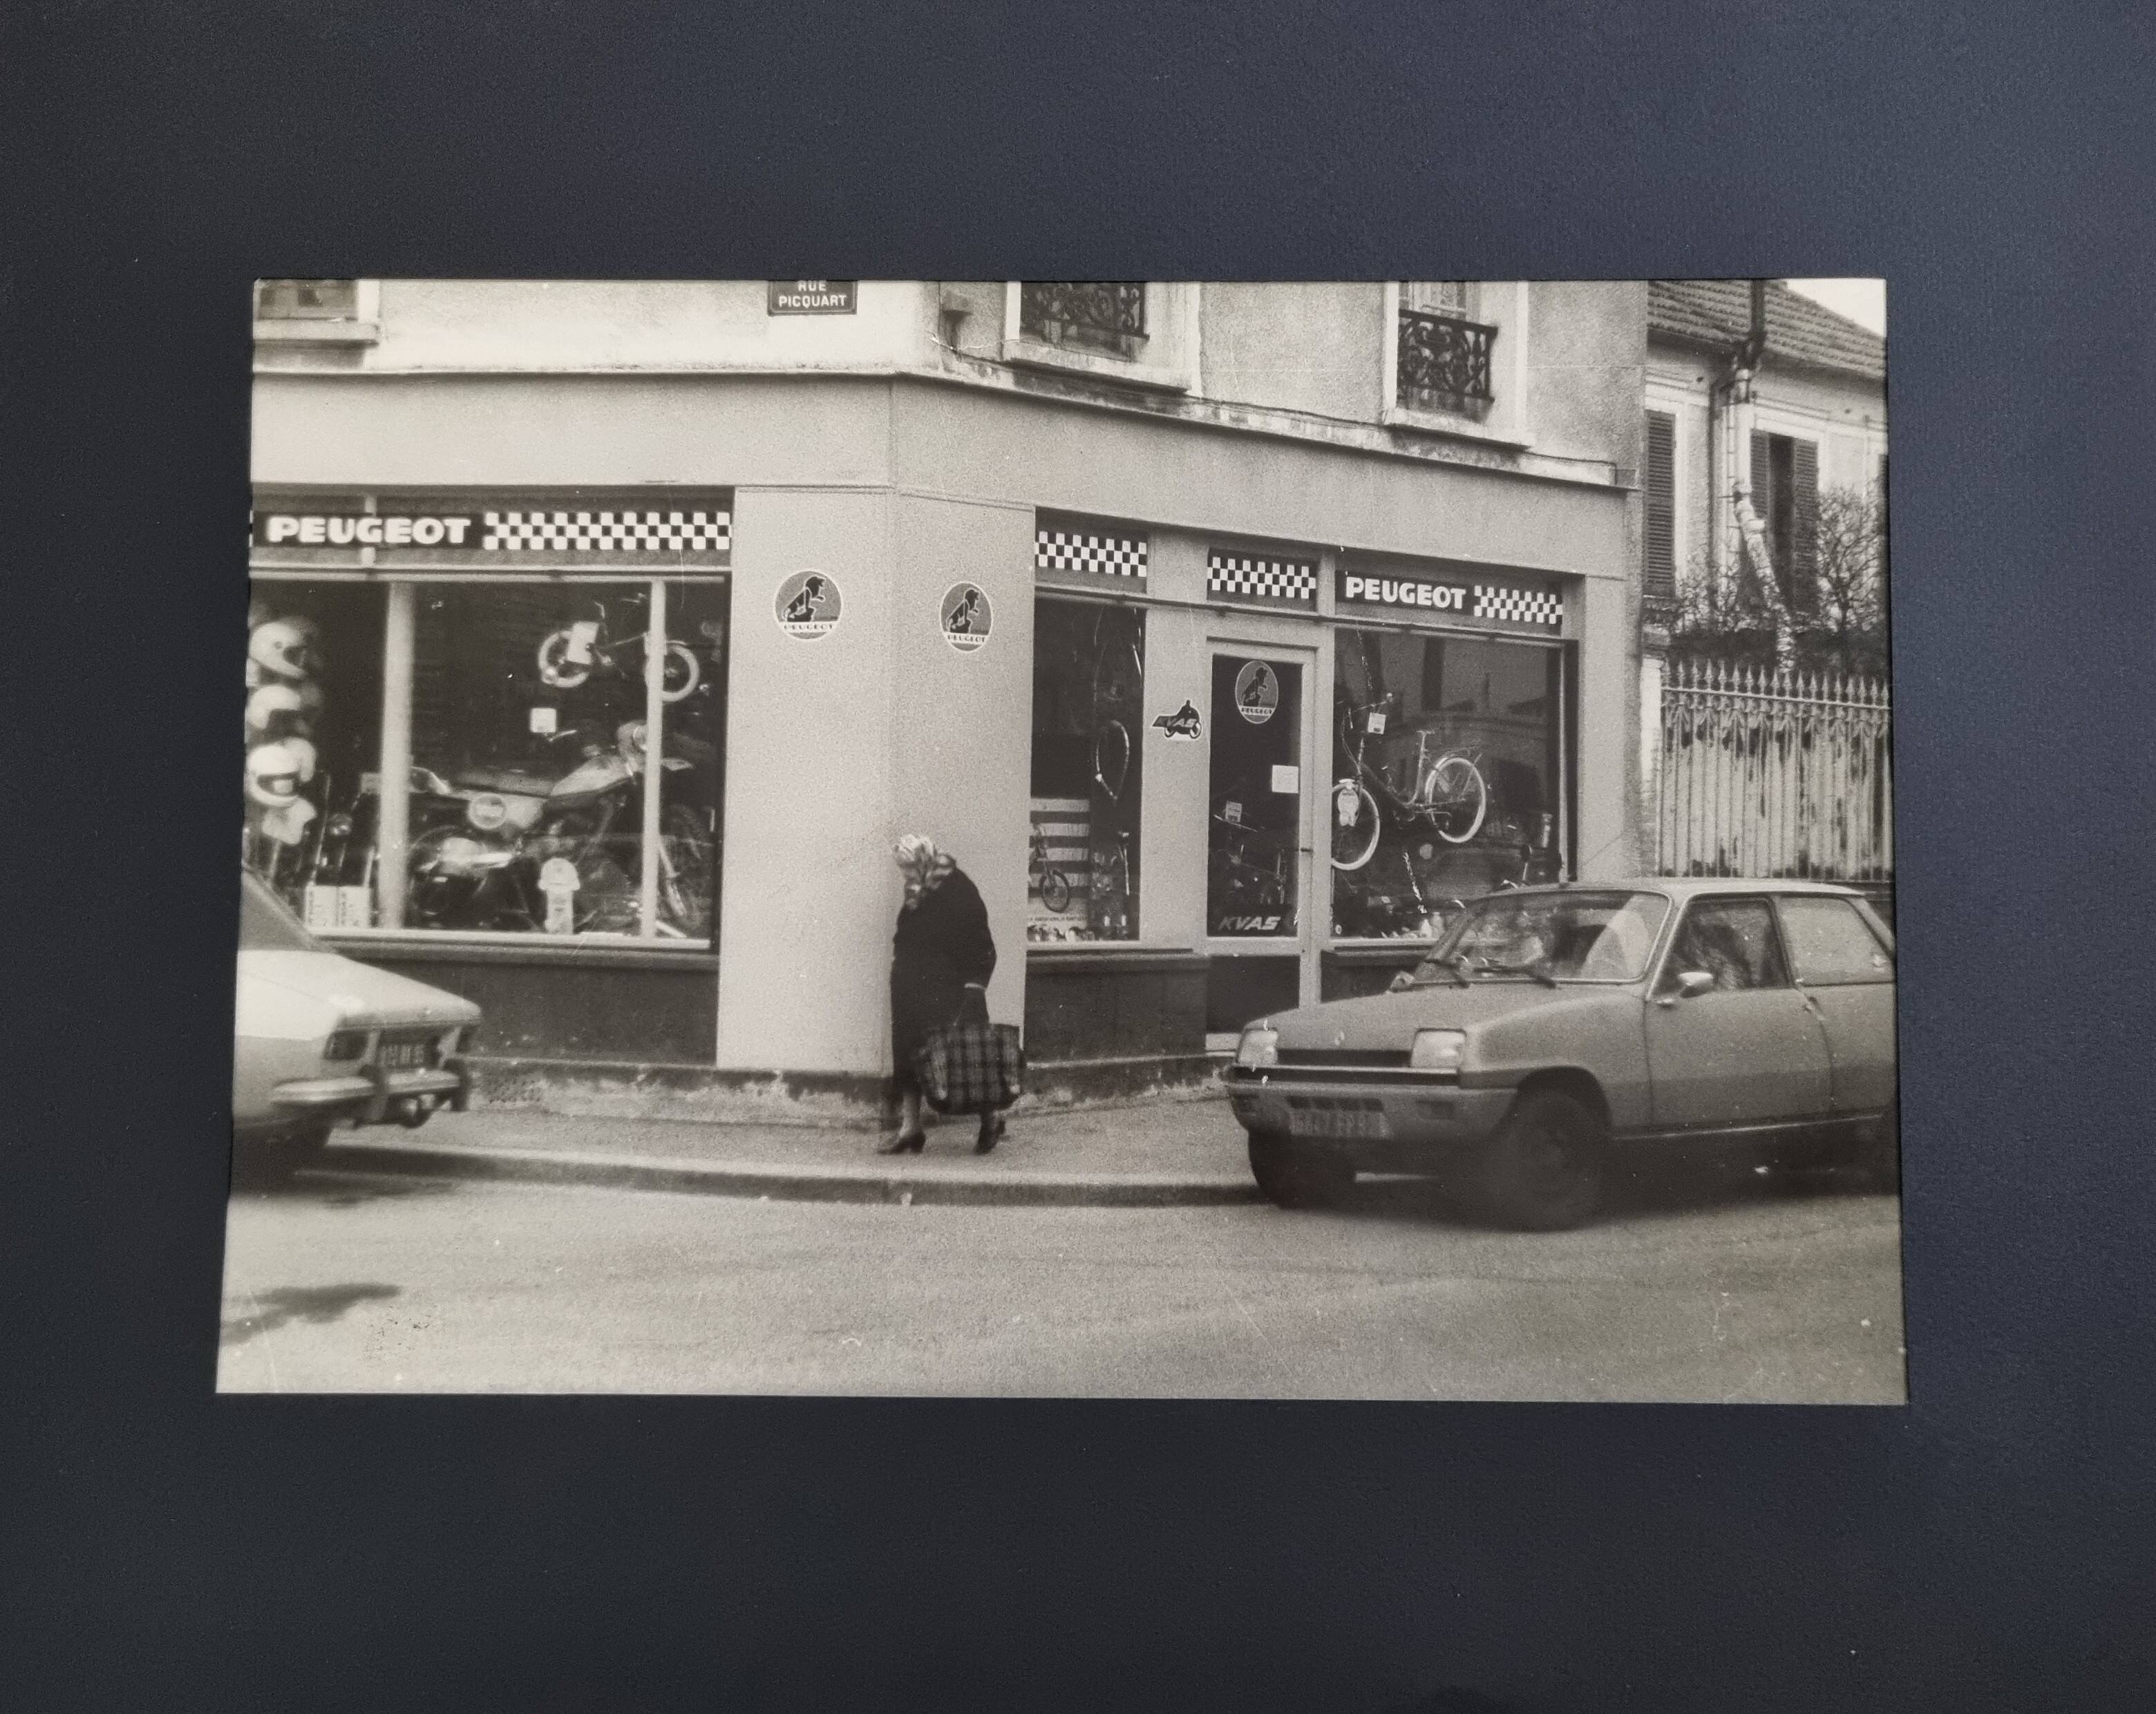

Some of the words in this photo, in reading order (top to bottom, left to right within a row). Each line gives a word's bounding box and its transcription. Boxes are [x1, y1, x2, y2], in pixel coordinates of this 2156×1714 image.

[797, 280, 827, 292] RUE
[778, 294, 847, 308] PICQUART
[267, 517, 471, 544] PEUGEOT
[1345, 576, 1466, 609] PEUGEOT
